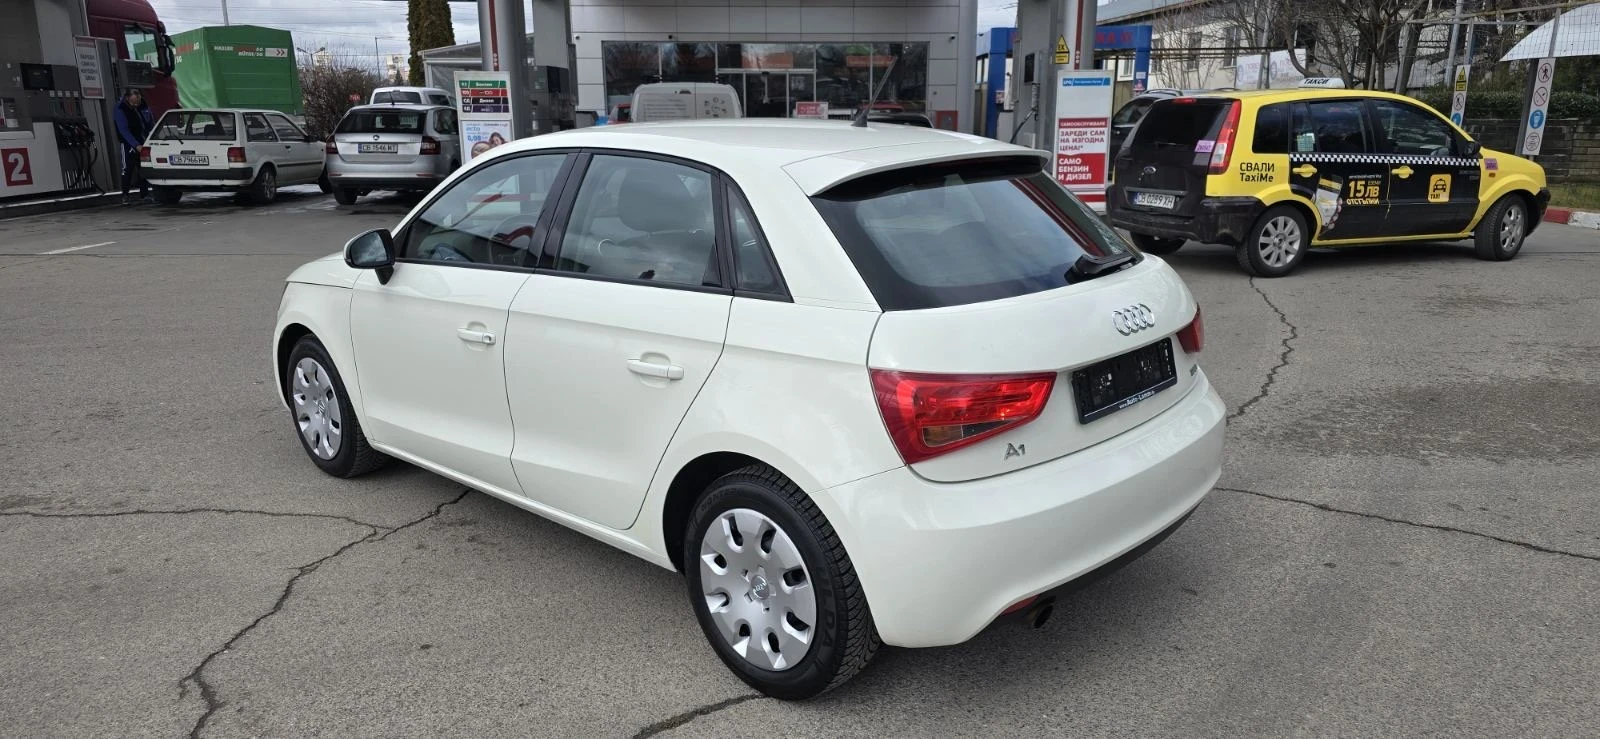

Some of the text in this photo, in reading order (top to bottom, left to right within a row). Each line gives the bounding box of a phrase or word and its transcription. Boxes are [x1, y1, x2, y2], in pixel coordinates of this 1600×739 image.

[8, 152, 28, 182] 2
[1058, 165, 1089, 173] БЕНЗИН
[1239, 162, 1276, 173] СВАЛИ
[1066, 173, 1092, 181] ДИЗЕЛ
[1240, 172, 1274, 183] TaxiMe
[1349, 181, 1366, 197] 15
[1004, 442, 1026, 461] A1
